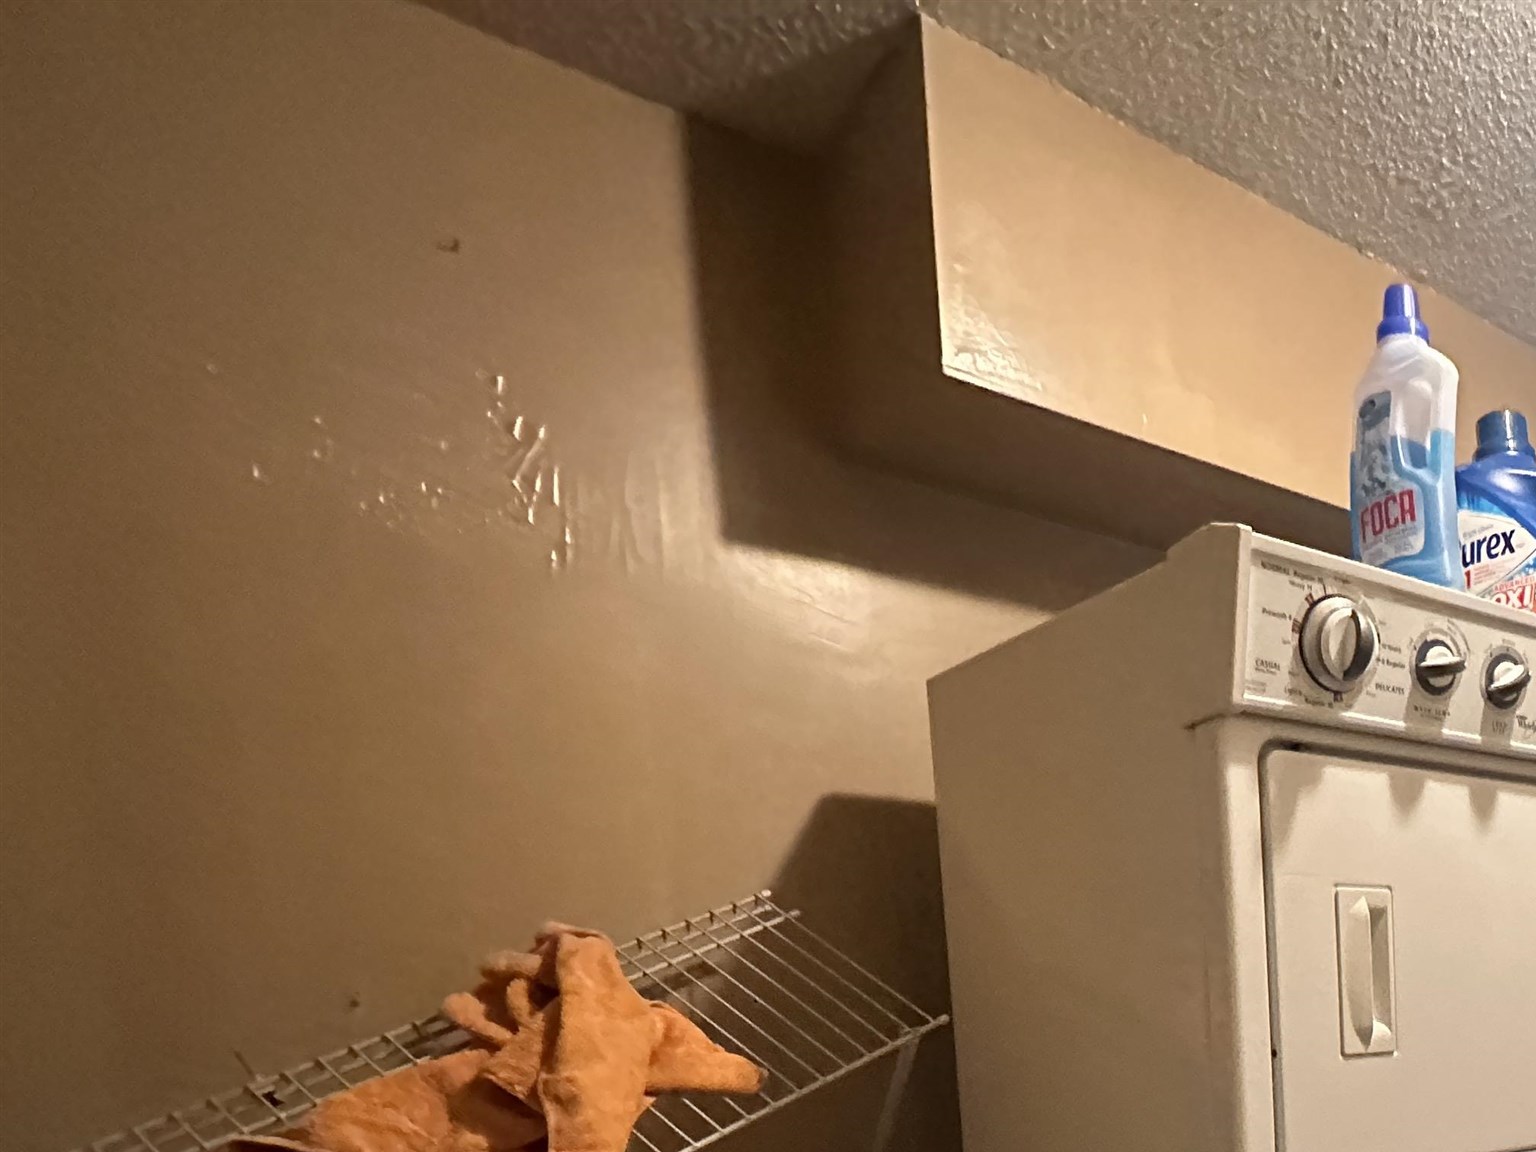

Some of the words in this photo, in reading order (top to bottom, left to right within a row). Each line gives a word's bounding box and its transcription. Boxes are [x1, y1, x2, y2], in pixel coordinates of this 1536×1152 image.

[1360, 488, 1417, 544] FOCA
[1461, 529, 1515, 568] urex
[1375, 683, 1405, 696] DELICATES
